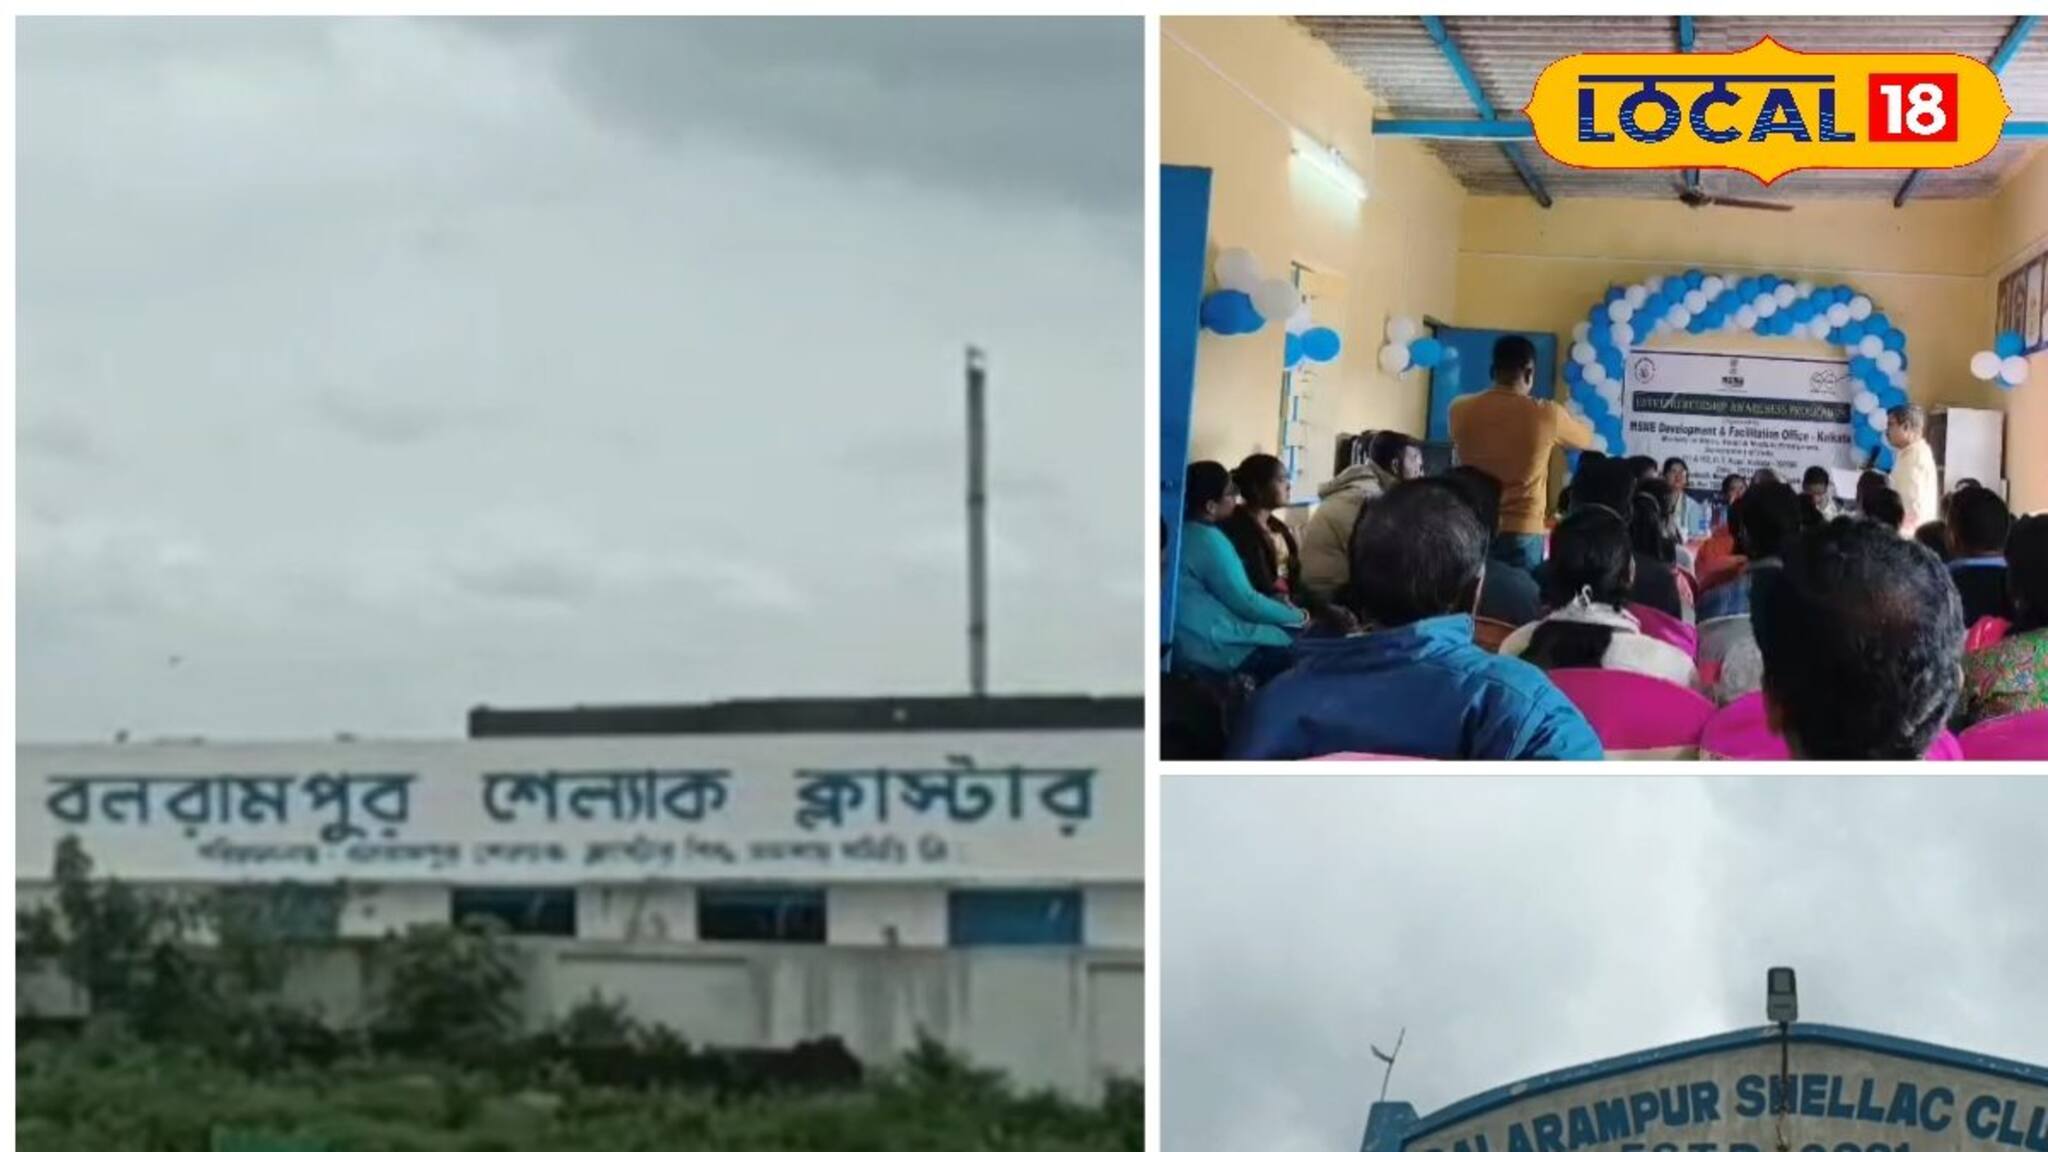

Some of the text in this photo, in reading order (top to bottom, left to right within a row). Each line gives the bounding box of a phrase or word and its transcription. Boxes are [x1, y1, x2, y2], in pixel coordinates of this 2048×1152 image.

[1658, 422, 1718, 437] Development
[1728, 426, 1780, 440] Facilitation
[1781, 428, 1810, 441] Office
[45, 753, 1099, 842] বলরামপুর শেল্যাক ক্লাস্টার
[1424, 1080, 1720, 1152] ARAMPUR
[1735, 1073, 1956, 1132] SHELLAC
